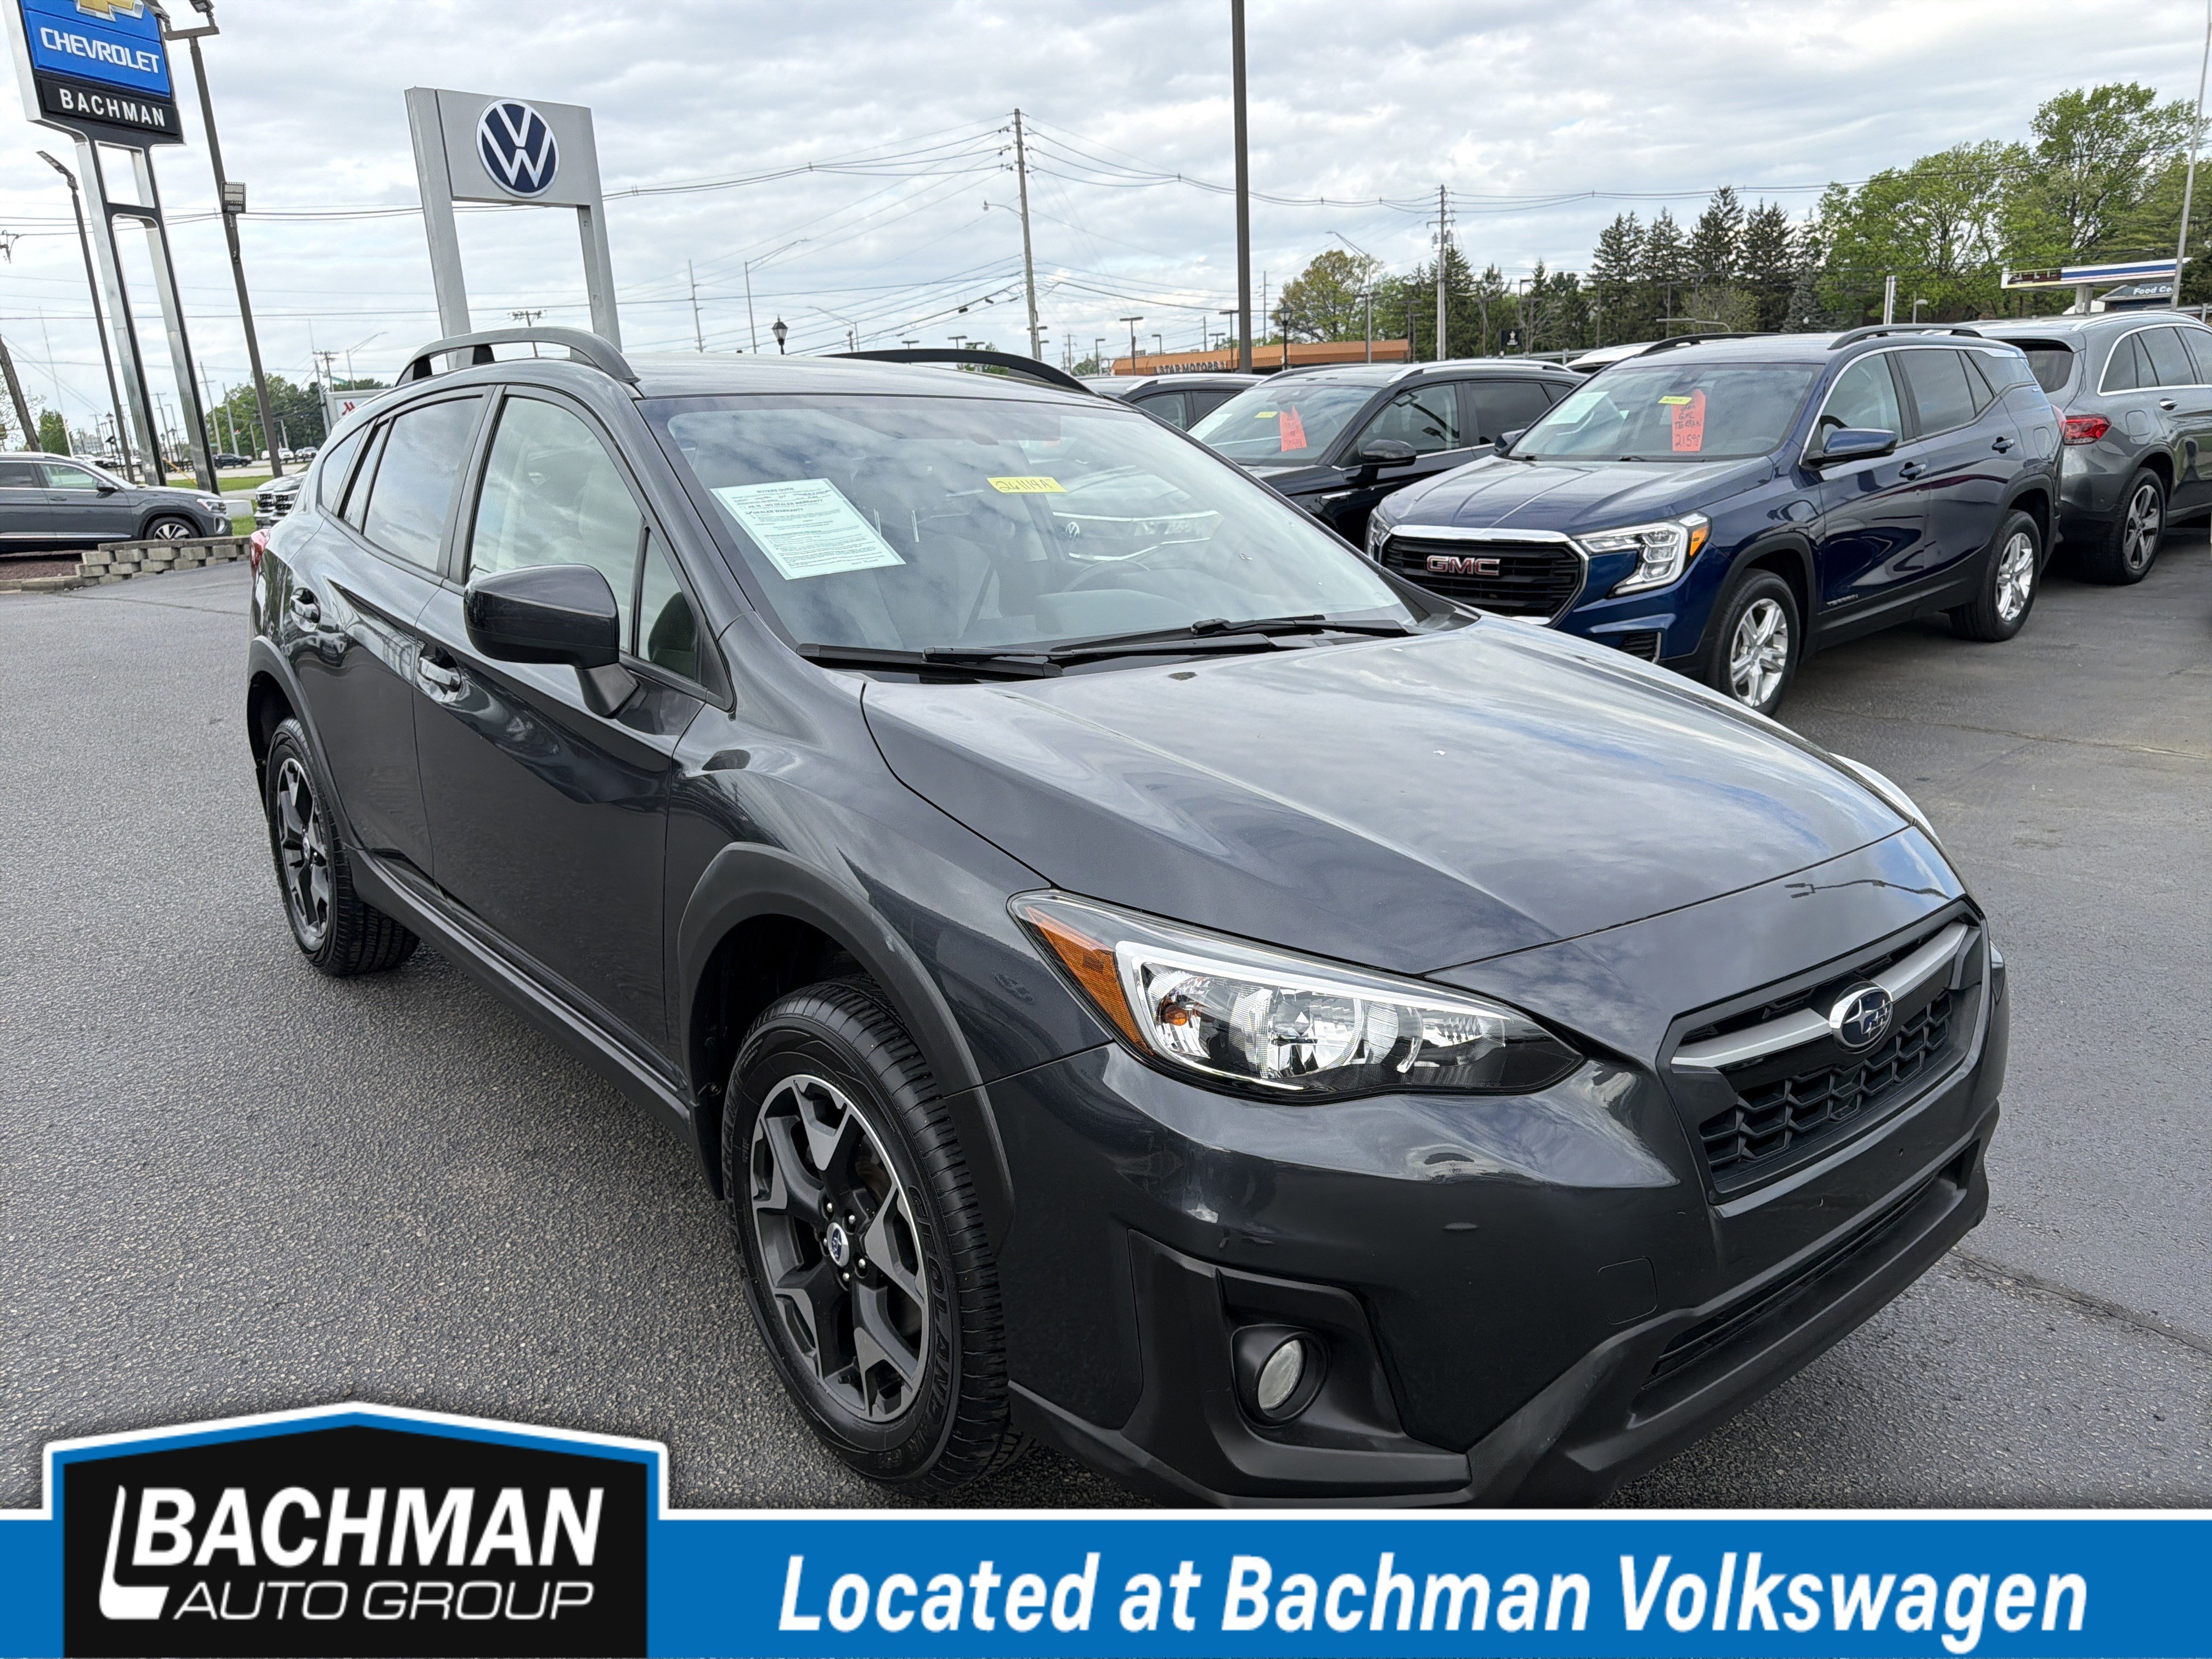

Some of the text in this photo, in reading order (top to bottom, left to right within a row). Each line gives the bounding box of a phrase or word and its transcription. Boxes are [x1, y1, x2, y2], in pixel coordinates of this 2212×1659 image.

[40, 27, 159, 74] CHEVROLET
[59, 88, 165, 127] BACHMAN
[478, 101, 556, 192] VW
[2133, 286, 2158, 295] Food
[1160, 364, 1180, 374] STAR
[1182, 360, 1219, 373] MOTORS
[1426, 555, 1501, 576] GMC
